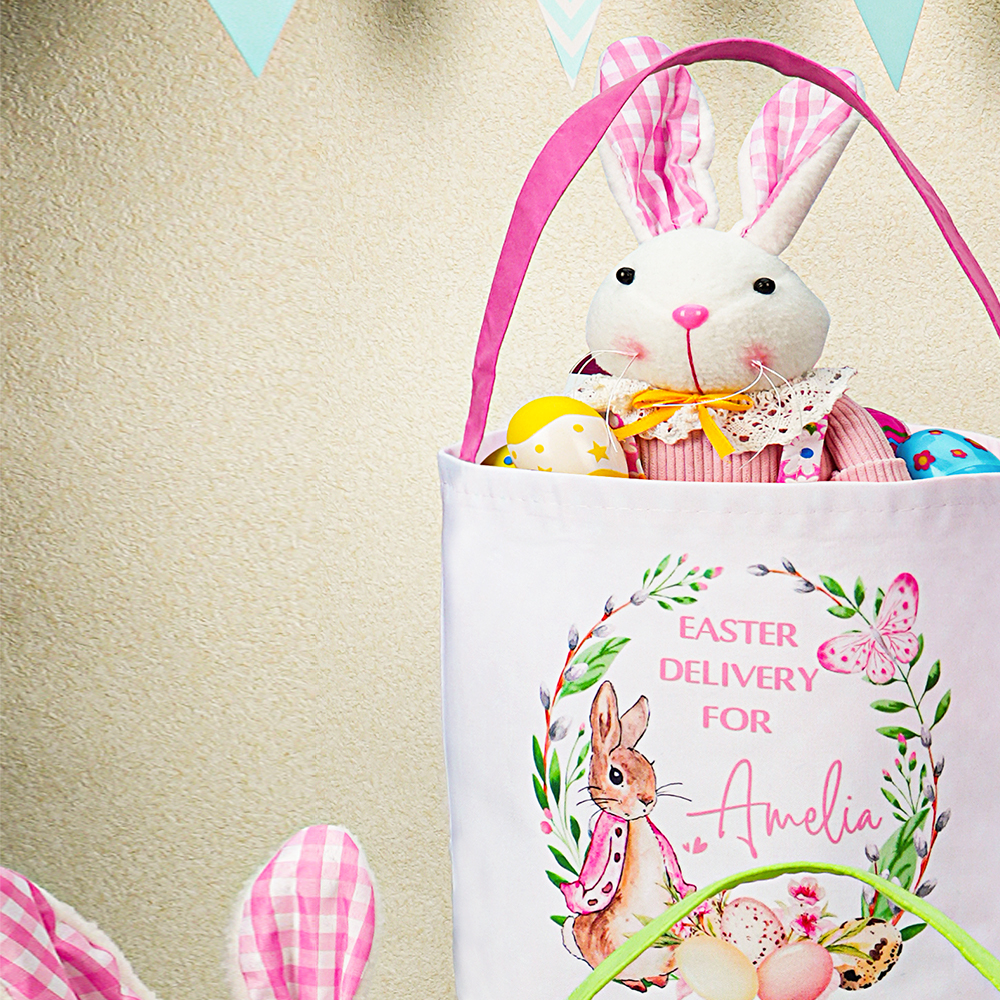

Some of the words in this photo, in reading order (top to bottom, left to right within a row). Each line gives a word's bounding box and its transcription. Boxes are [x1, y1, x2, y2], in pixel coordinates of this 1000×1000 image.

[679, 615, 799, 648] EASTER
[660, 657, 819, 693] DELIVERY
[702, 705, 773, 734] FOR
[686, 758, 883, 859] Amelia
